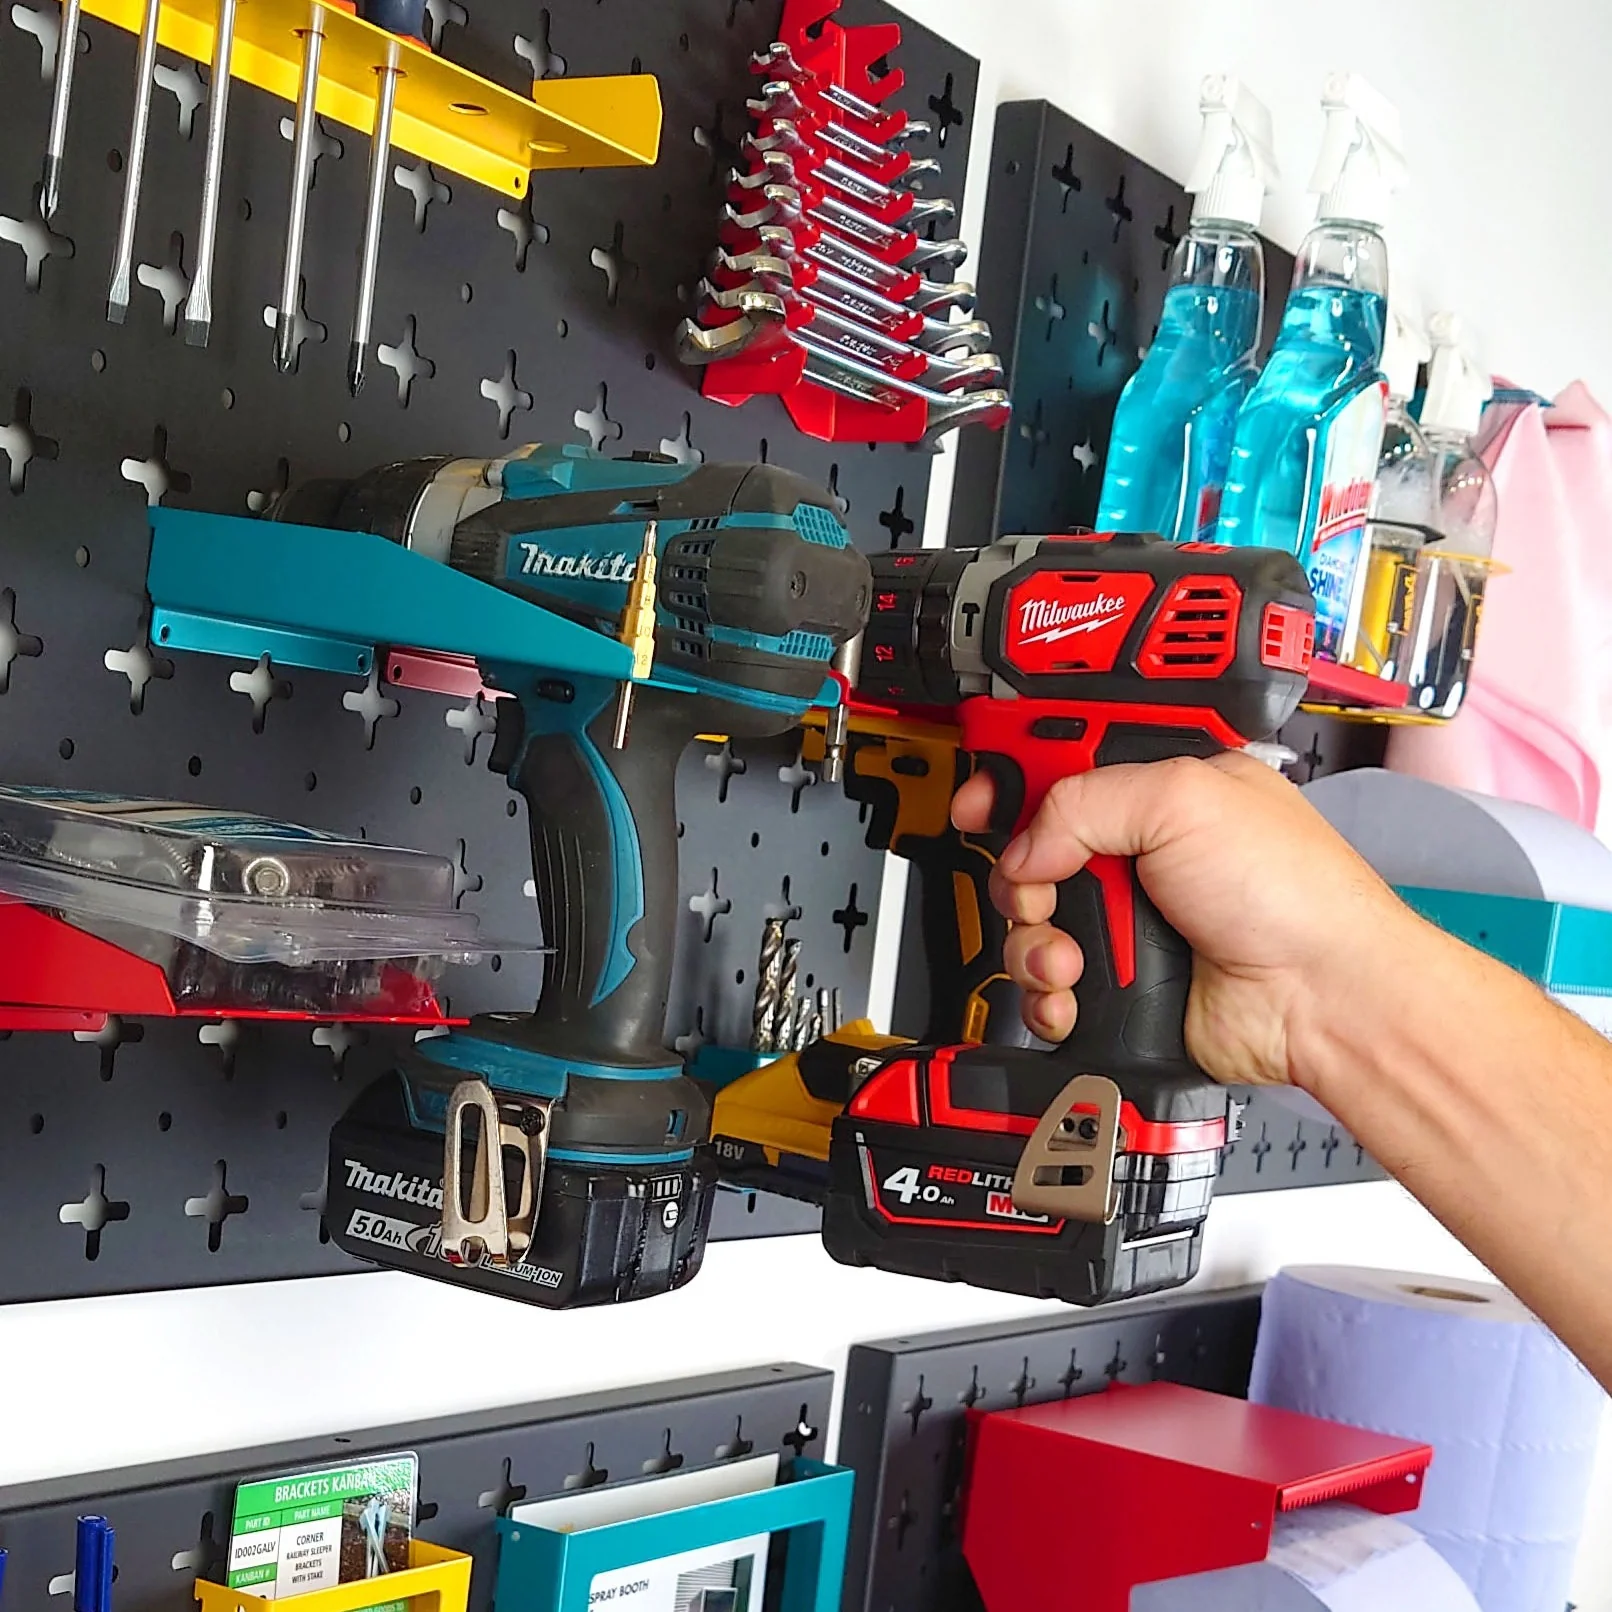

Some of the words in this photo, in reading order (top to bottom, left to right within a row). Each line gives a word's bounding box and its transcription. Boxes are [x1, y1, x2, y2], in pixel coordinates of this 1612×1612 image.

[1019, 593, 1126, 634] Milwaukee
[714, 1140, 745, 1160] 18V
[274, 1477, 330, 1504] BRACKETS
[296, 1532, 324, 1546] CORNER
[295, 1559, 322, 1571] BRACKETS
[590, 1587, 617, 1604] SPRAY
[619, 1579, 649, 1597] BOOTH
